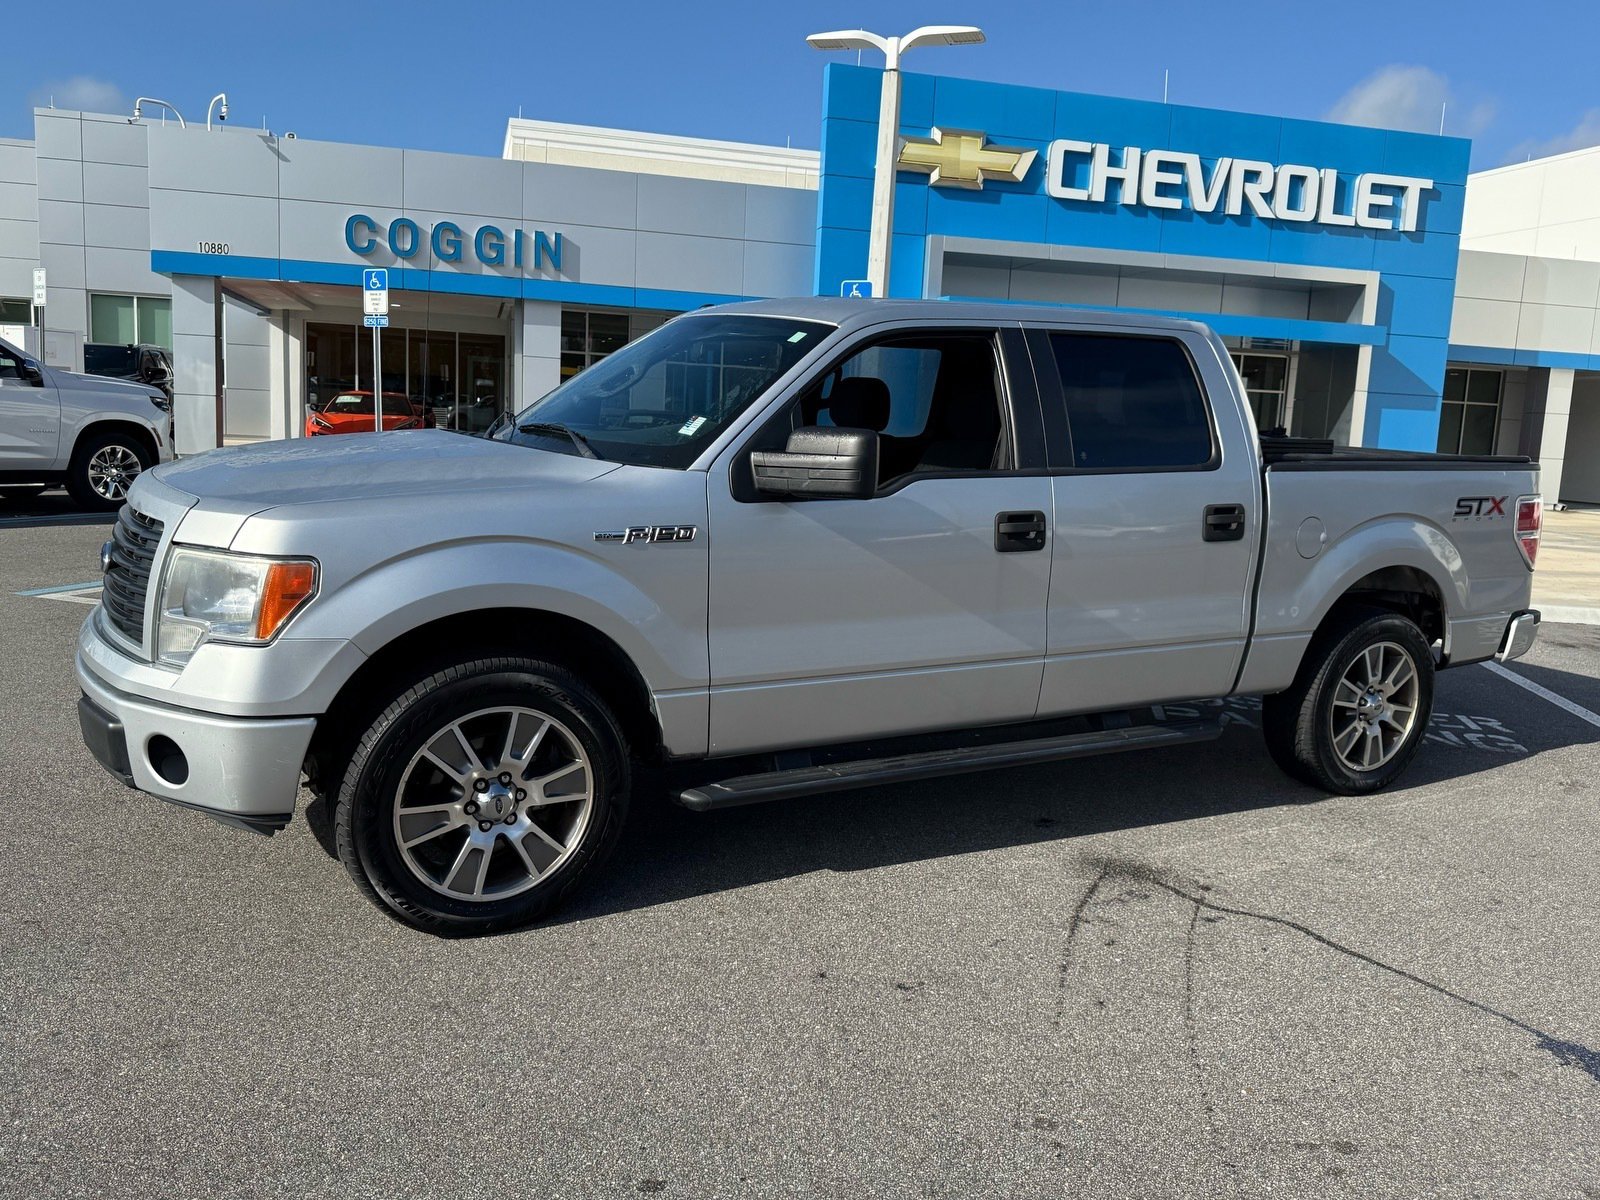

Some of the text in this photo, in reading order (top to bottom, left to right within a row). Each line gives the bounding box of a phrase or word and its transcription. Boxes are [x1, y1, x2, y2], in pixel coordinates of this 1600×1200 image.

[1047, 138, 1434, 232] CHEVROLET
[199, 242, 230, 255] 10880
[345, 214, 563, 272] COGGIN
[1453, 495, 1509, 517] STX
